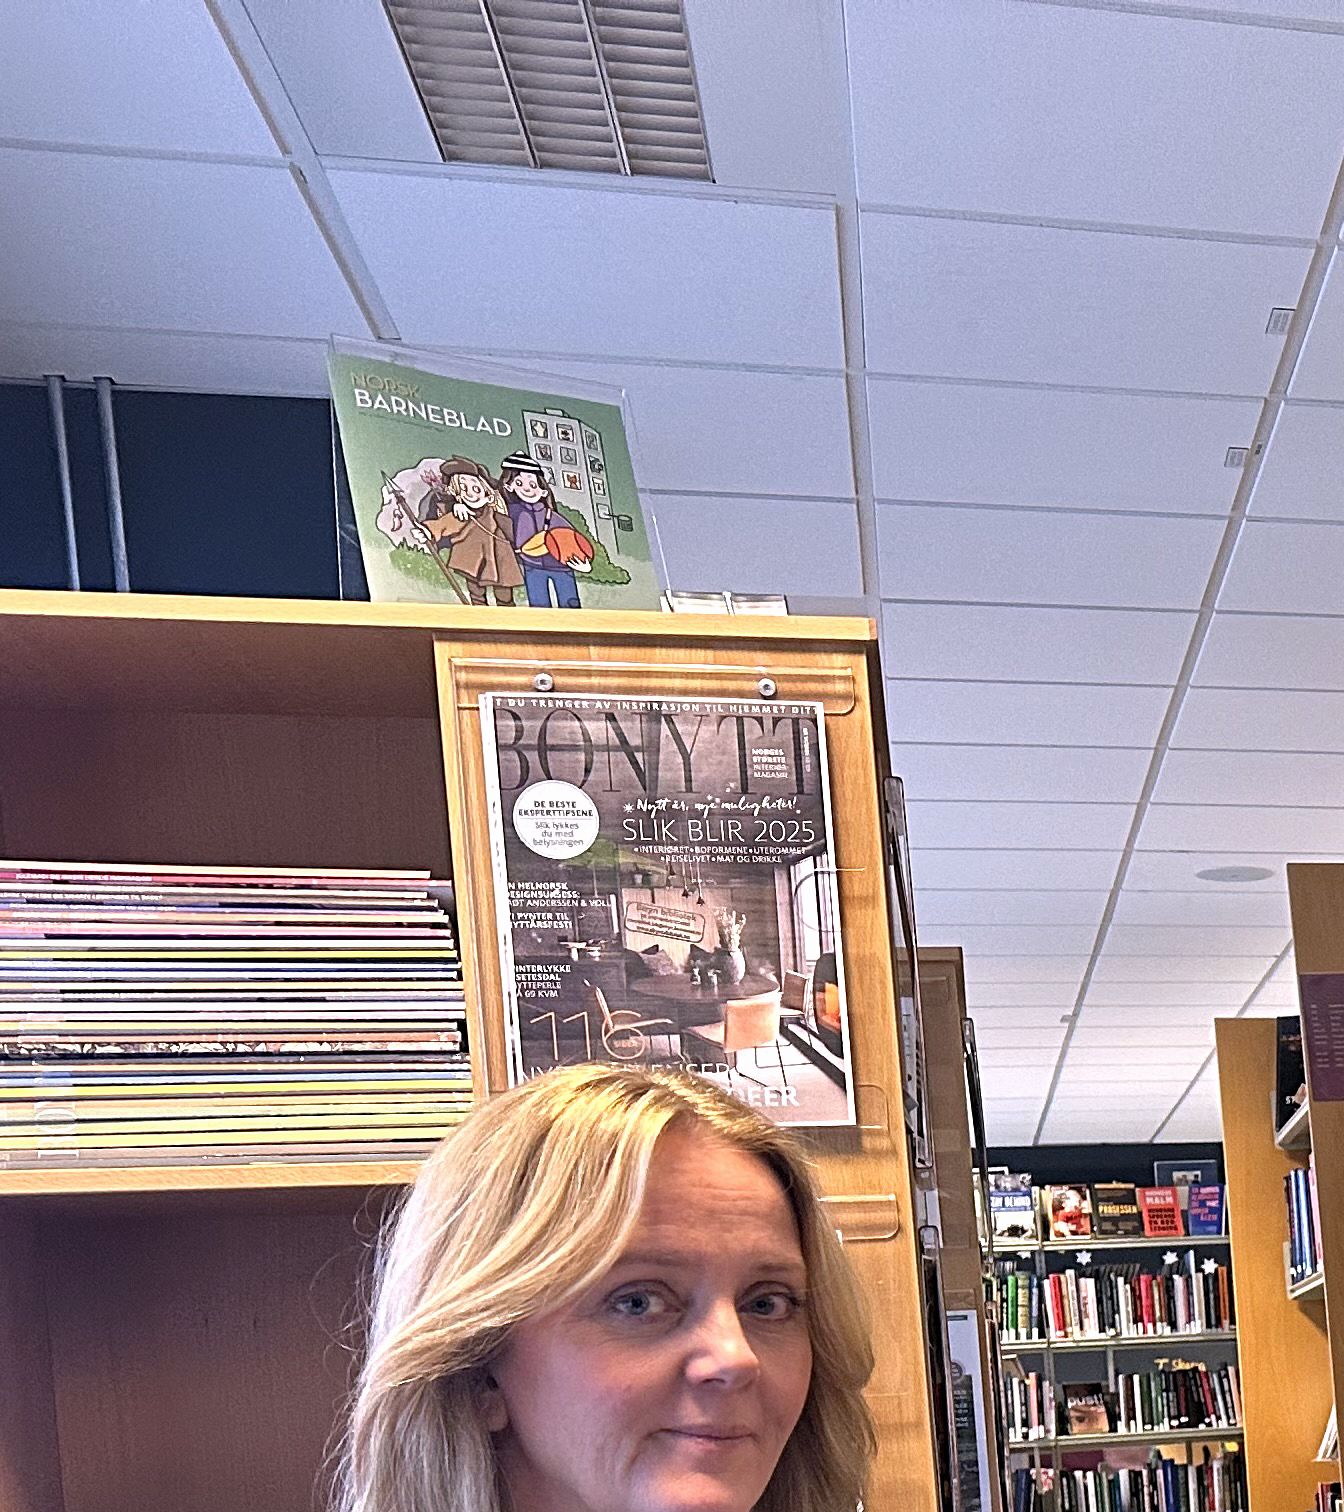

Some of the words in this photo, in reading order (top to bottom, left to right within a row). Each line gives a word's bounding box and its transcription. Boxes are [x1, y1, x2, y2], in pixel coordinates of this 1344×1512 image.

[351, 374, 420, 398] NORSK
[354, 388, 513, 437] BARNEBLAD
[508, 698, 526, 708] DU
[531, 699, 590, 709] TRENGER
[595, 700, 612, 710] AV
[617, 701, 700, 713] INSPIRASJON
[705, 704, 724, 713] TIL
[495, 707, 818, 796] BONYTT
[518, 809, 594, 817] EKSPERTTIPSENE
[549, 800, 577, 808] BESTE
[637, 797, 671, 818] Nytt
[622, 819, 678, 842] SLIK
[688, 819, 745, 843] BLIR
[754, 820, 816, 843] 2025
[514, 964, 571, 973] INTERLYKKE
[515, 981, 561, 990] YTTEPERLE
[529, 1009, 646, 1061] 116
